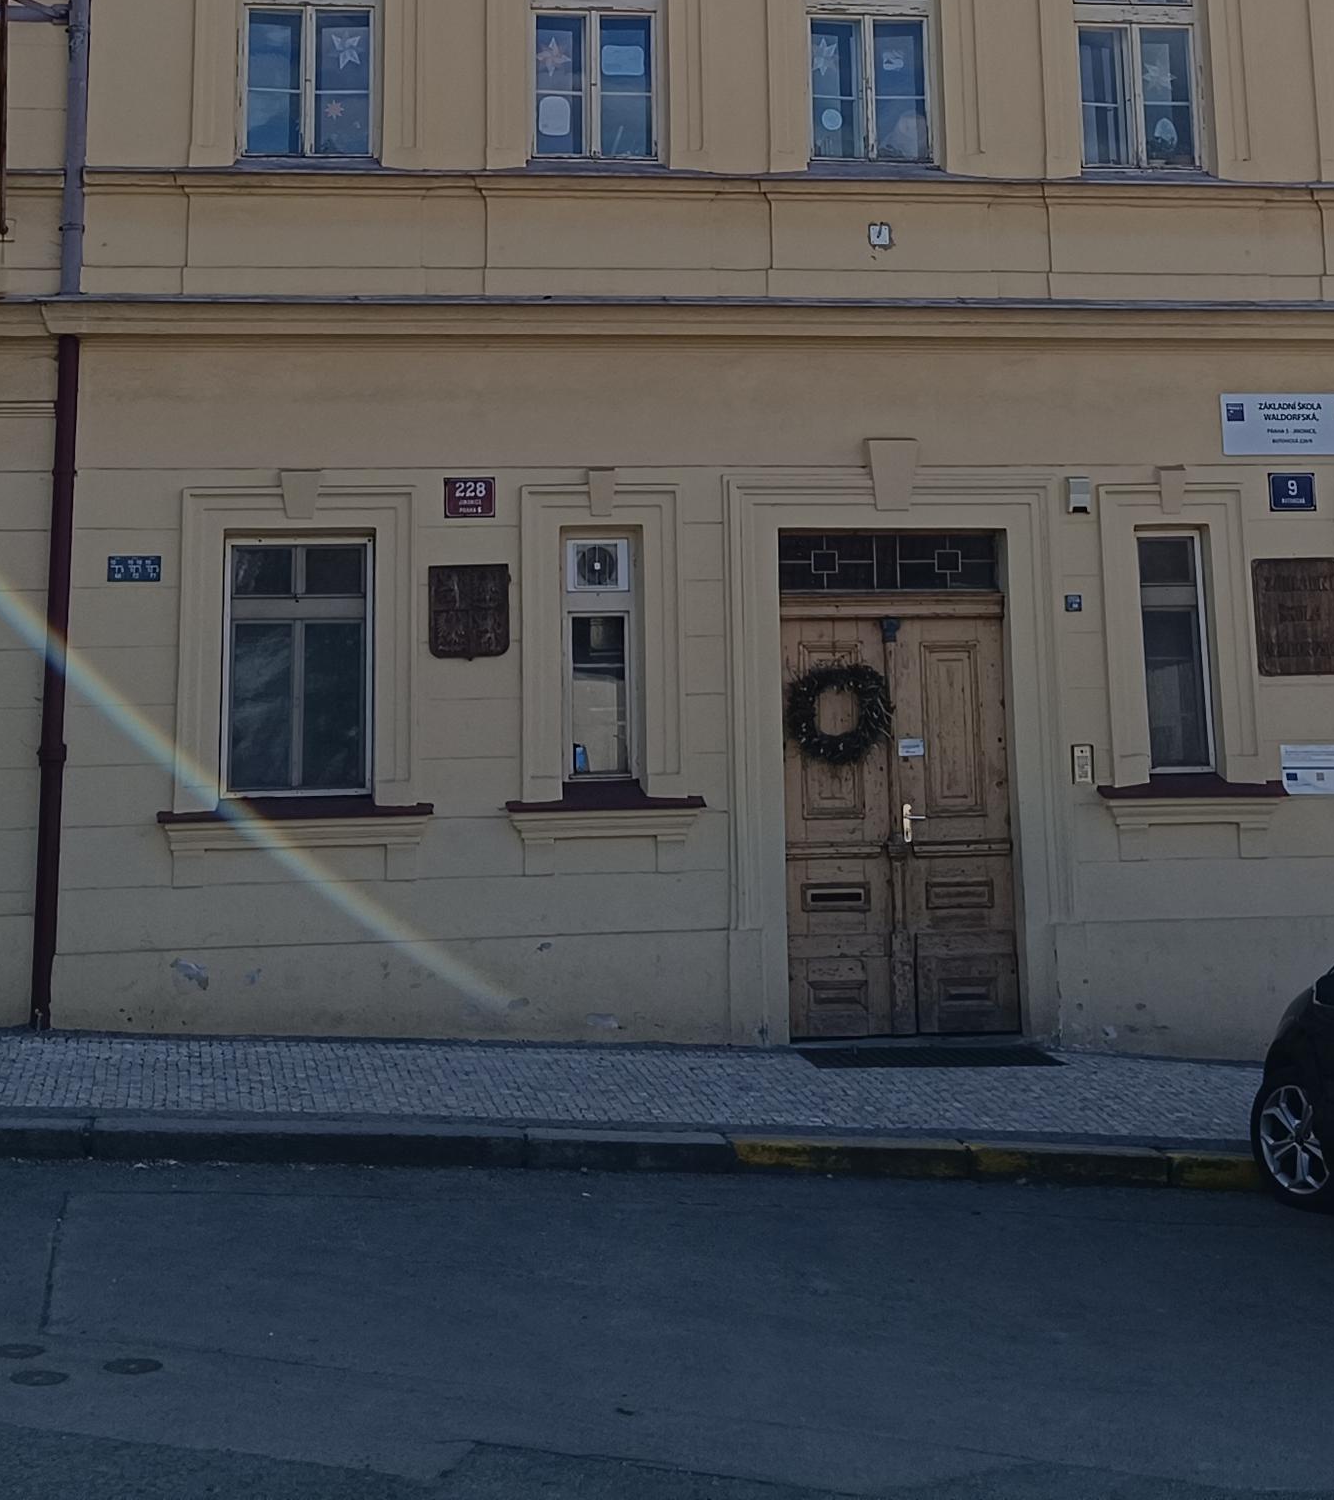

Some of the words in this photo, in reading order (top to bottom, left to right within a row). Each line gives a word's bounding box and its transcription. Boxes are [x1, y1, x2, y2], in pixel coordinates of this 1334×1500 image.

[1258, 401, 1296, 410] ZÁKLADNÍ
[1297, 401, 1322, 410] ŠKOLA
[455, 482, 486, 497] 228
[1288, 480, 1297, 495] 9
